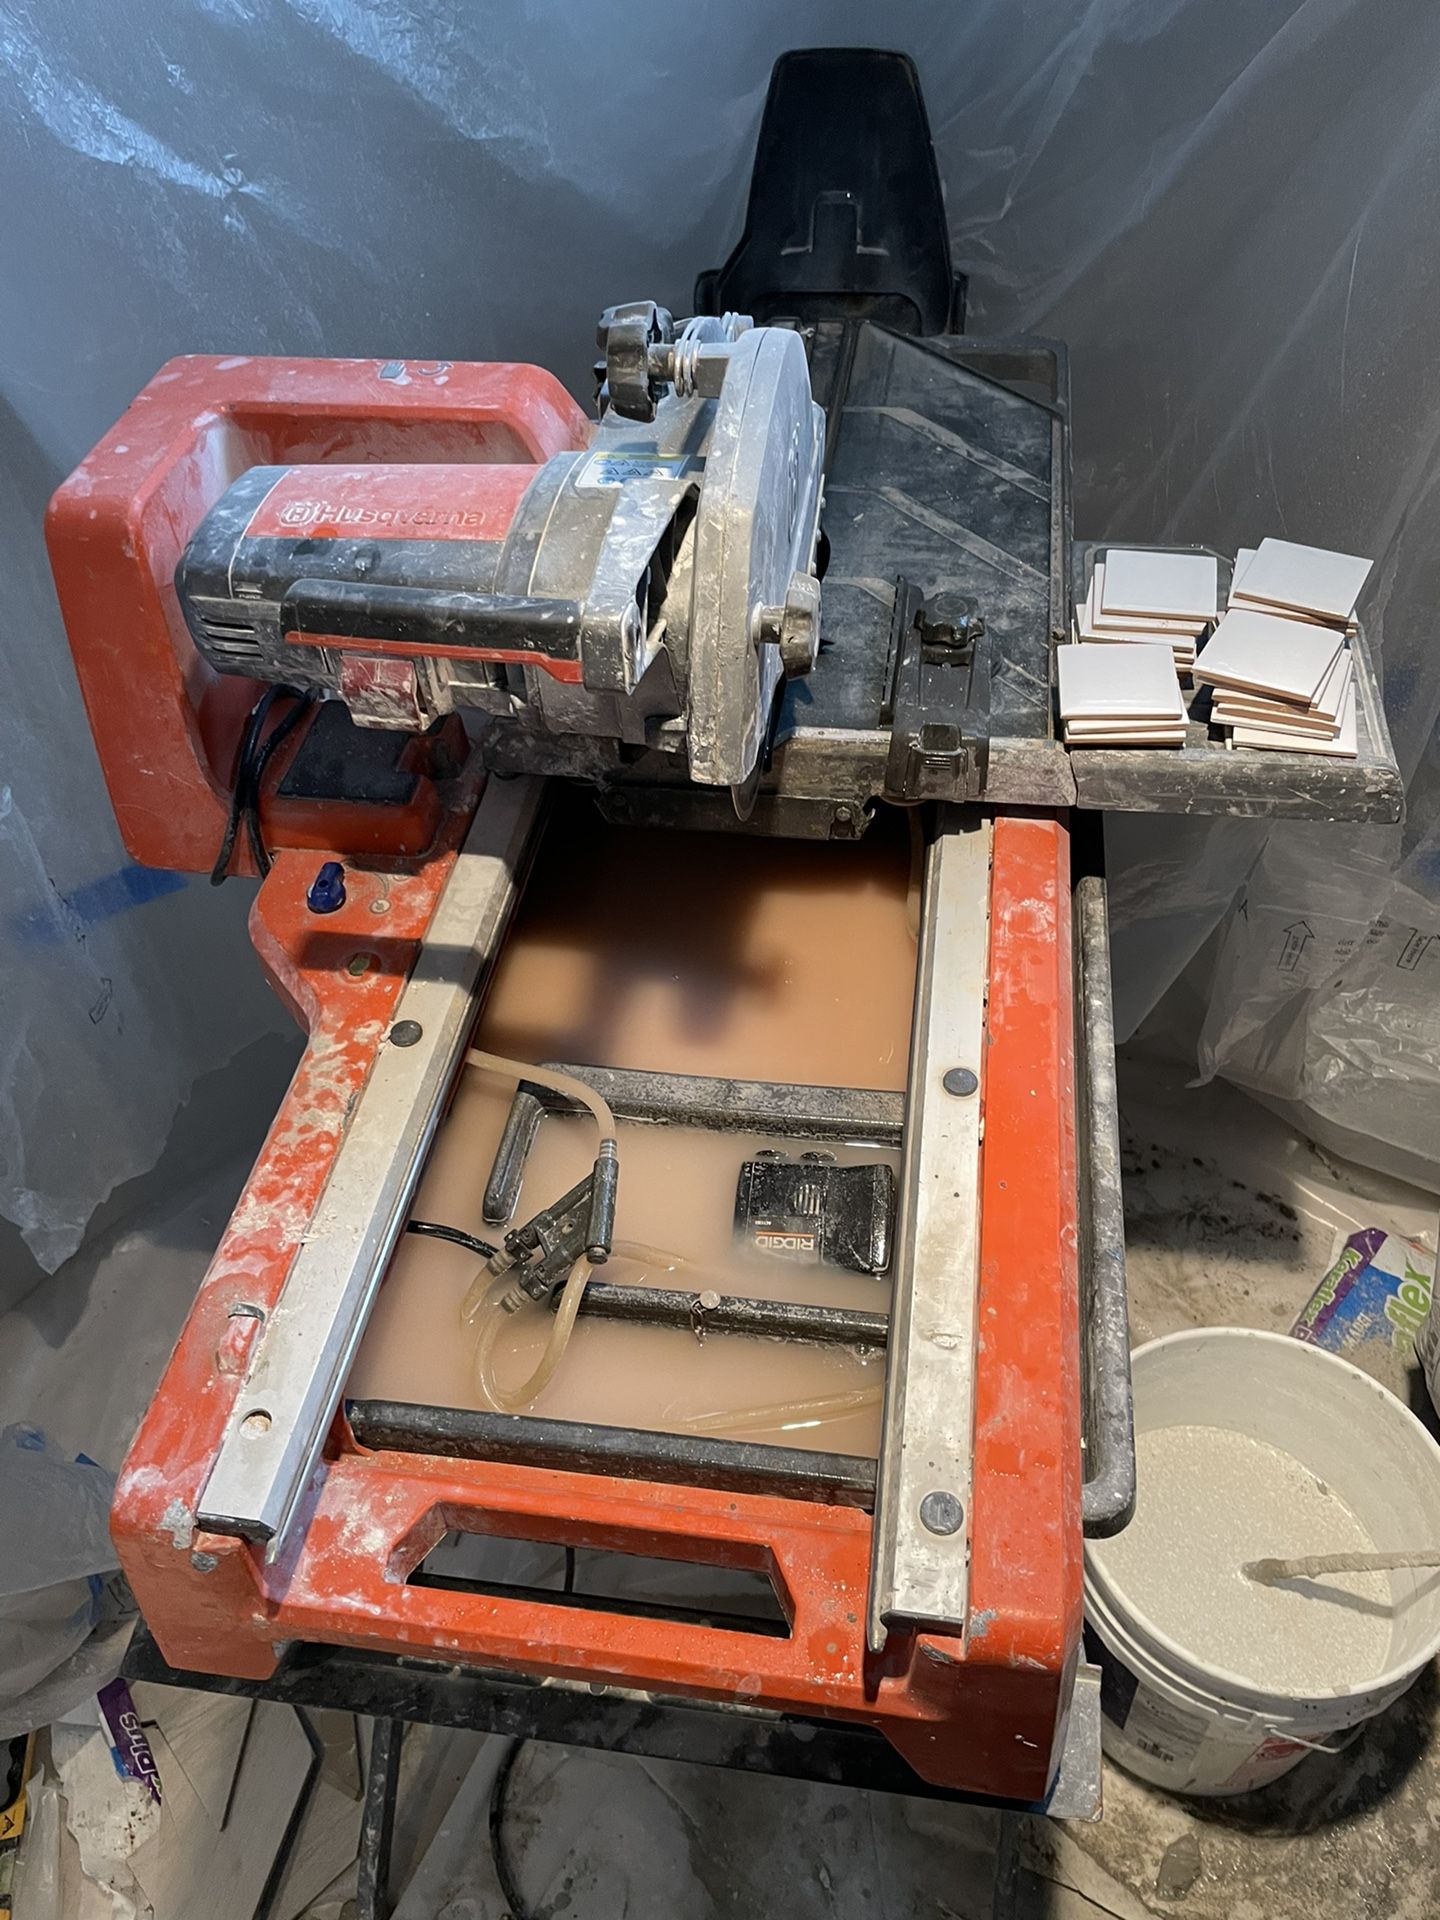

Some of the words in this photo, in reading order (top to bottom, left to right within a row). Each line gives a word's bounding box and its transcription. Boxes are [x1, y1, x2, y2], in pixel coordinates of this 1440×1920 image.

[314, 501, 486, 527] Husqvarna
[755, 1235, 815, 1250] RIDGID
[1301, 1247, 1363, 1326] Keraflex
